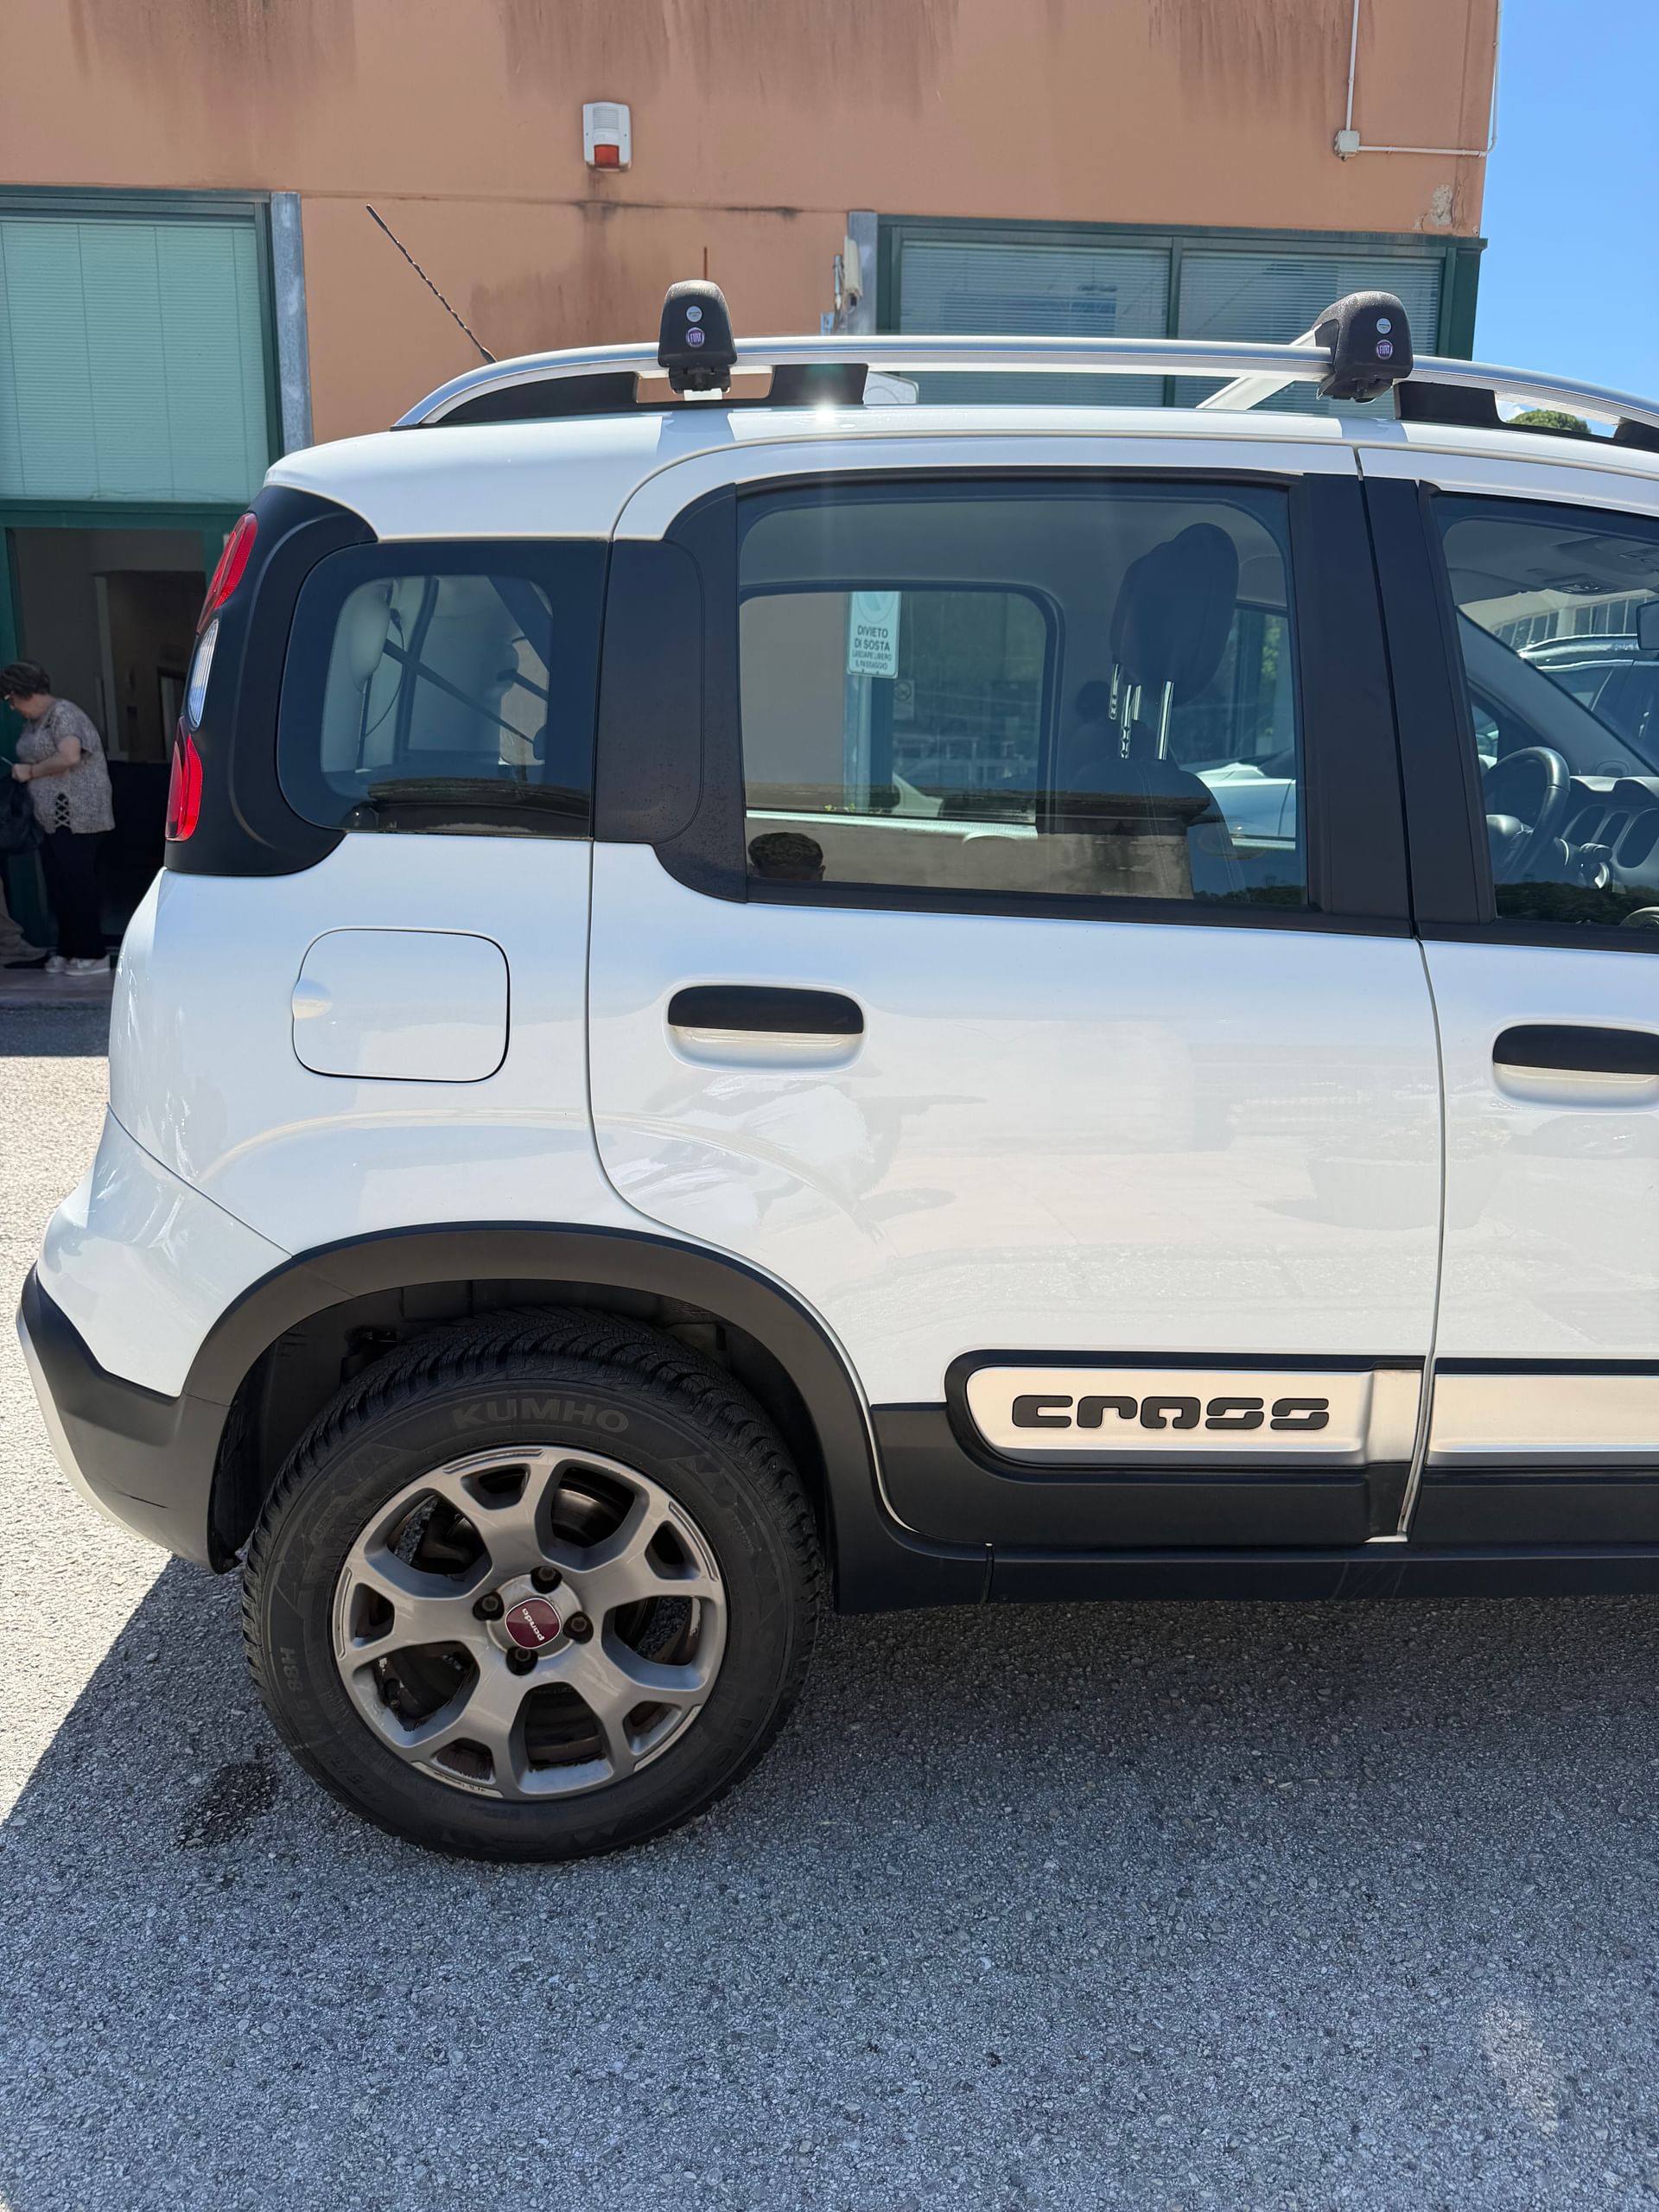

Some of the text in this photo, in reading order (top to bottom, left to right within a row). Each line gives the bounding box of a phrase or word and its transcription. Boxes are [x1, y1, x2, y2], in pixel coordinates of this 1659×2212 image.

[690, 333, 702, 343] FIAT
[1379, 345, 1390, 354] FIAT
[857, 625, 889, 639] DIVIETO
[855, 638, 891, 652] DI SOSTA
[452, 1397, 629, 1433] KUMHO
[522, 1608, 545, 1641] panda
